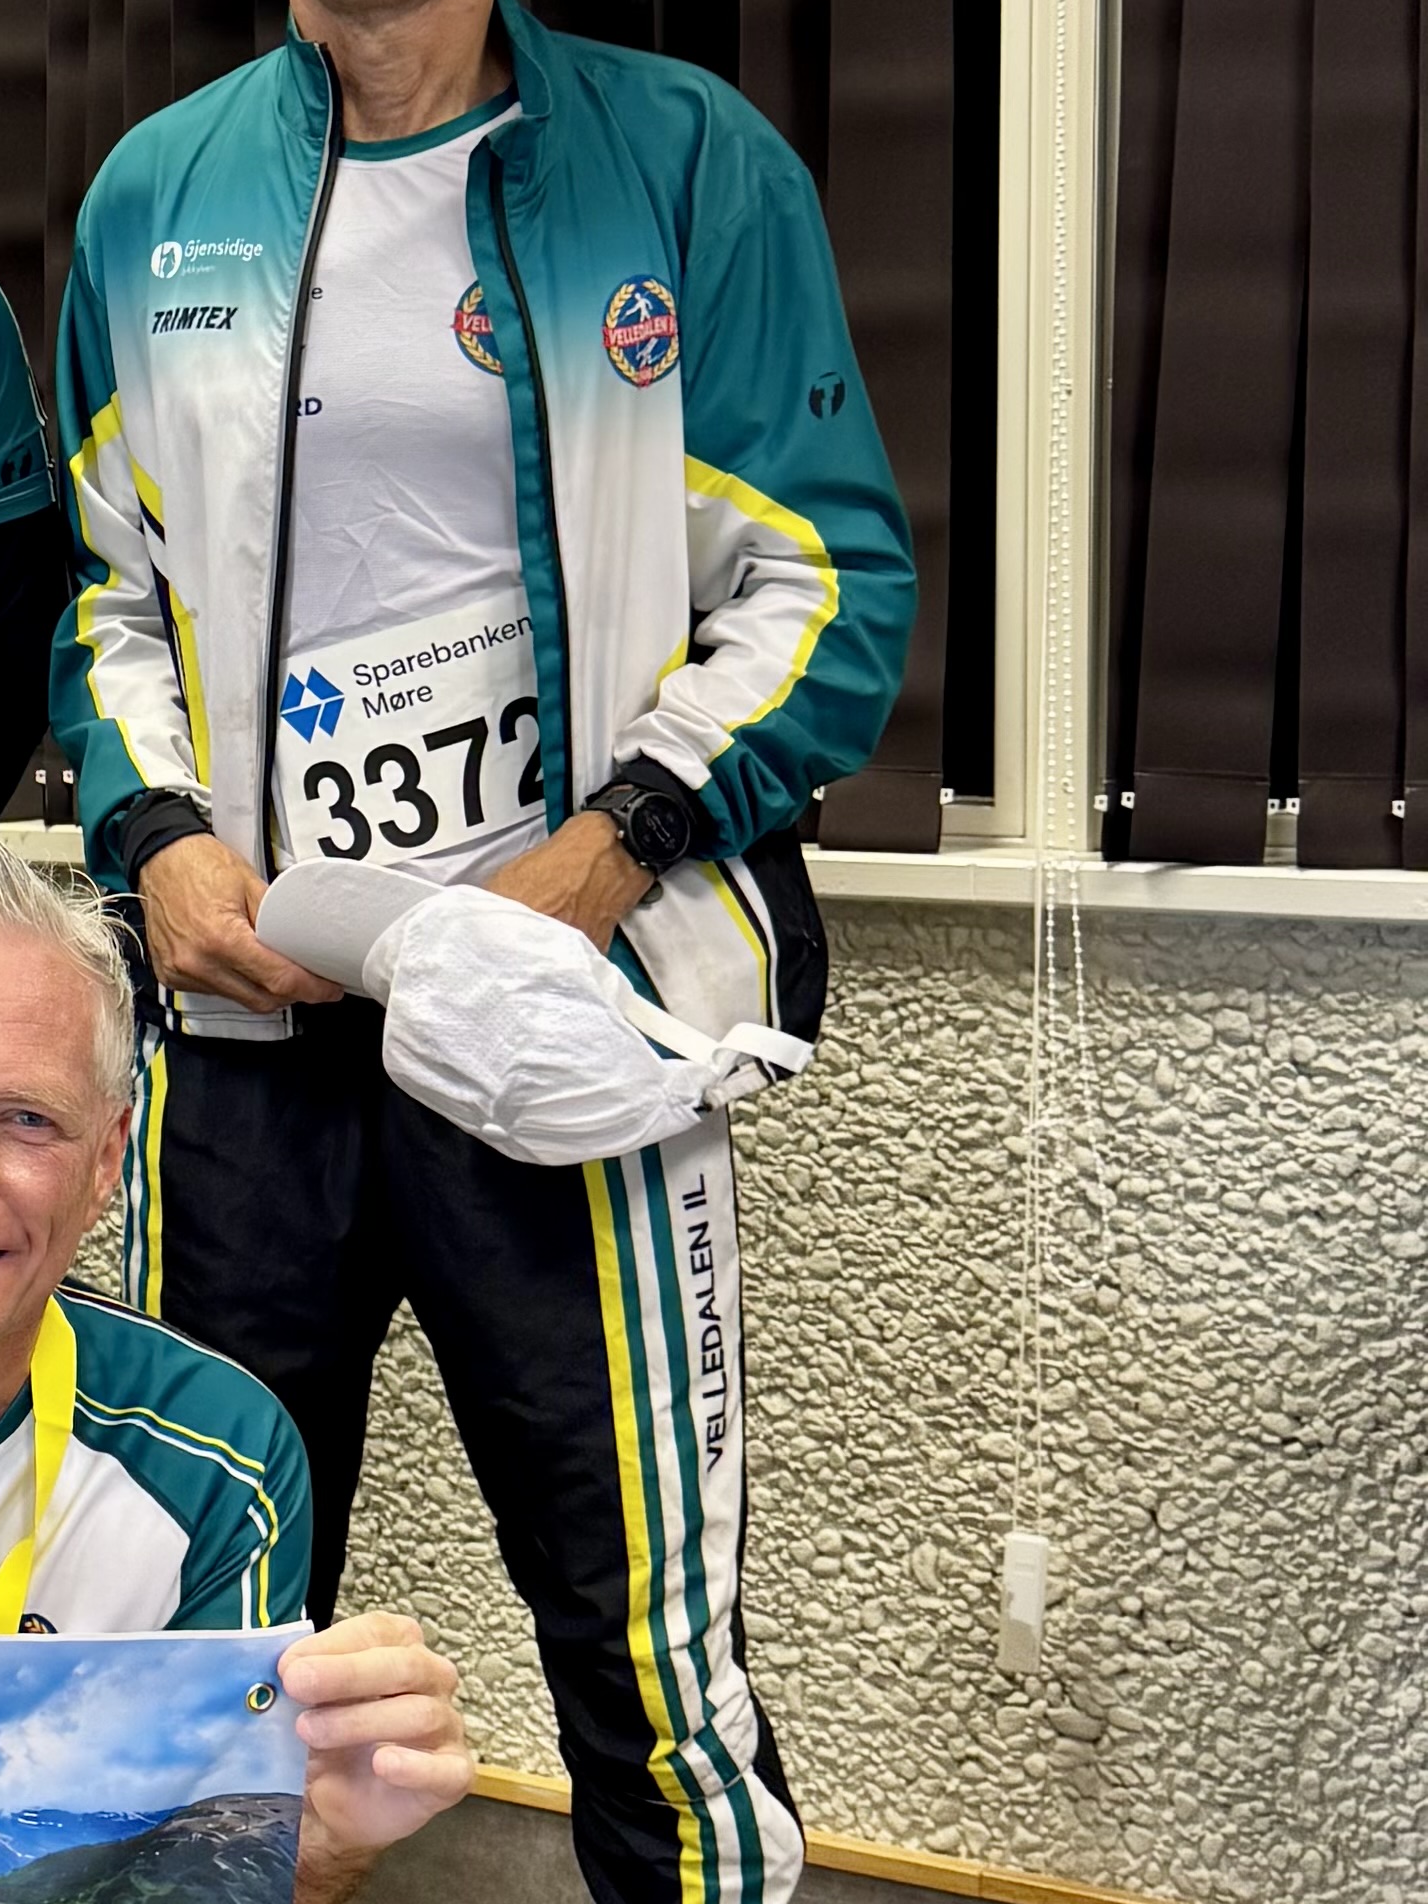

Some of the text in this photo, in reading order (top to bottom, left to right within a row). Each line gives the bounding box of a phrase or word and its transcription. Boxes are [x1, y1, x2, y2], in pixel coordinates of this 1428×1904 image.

[184, 237, 263, 262] Gjensidige
[151, 306, 238, 334] TRIMTEX
[352, 616, 534, 687] Sparebanken
[361, 685, 434, 718] Møre
[303, 696, 546, 861] 3372
[682, 1173, 727, 1473] VELLEDALEN IL
